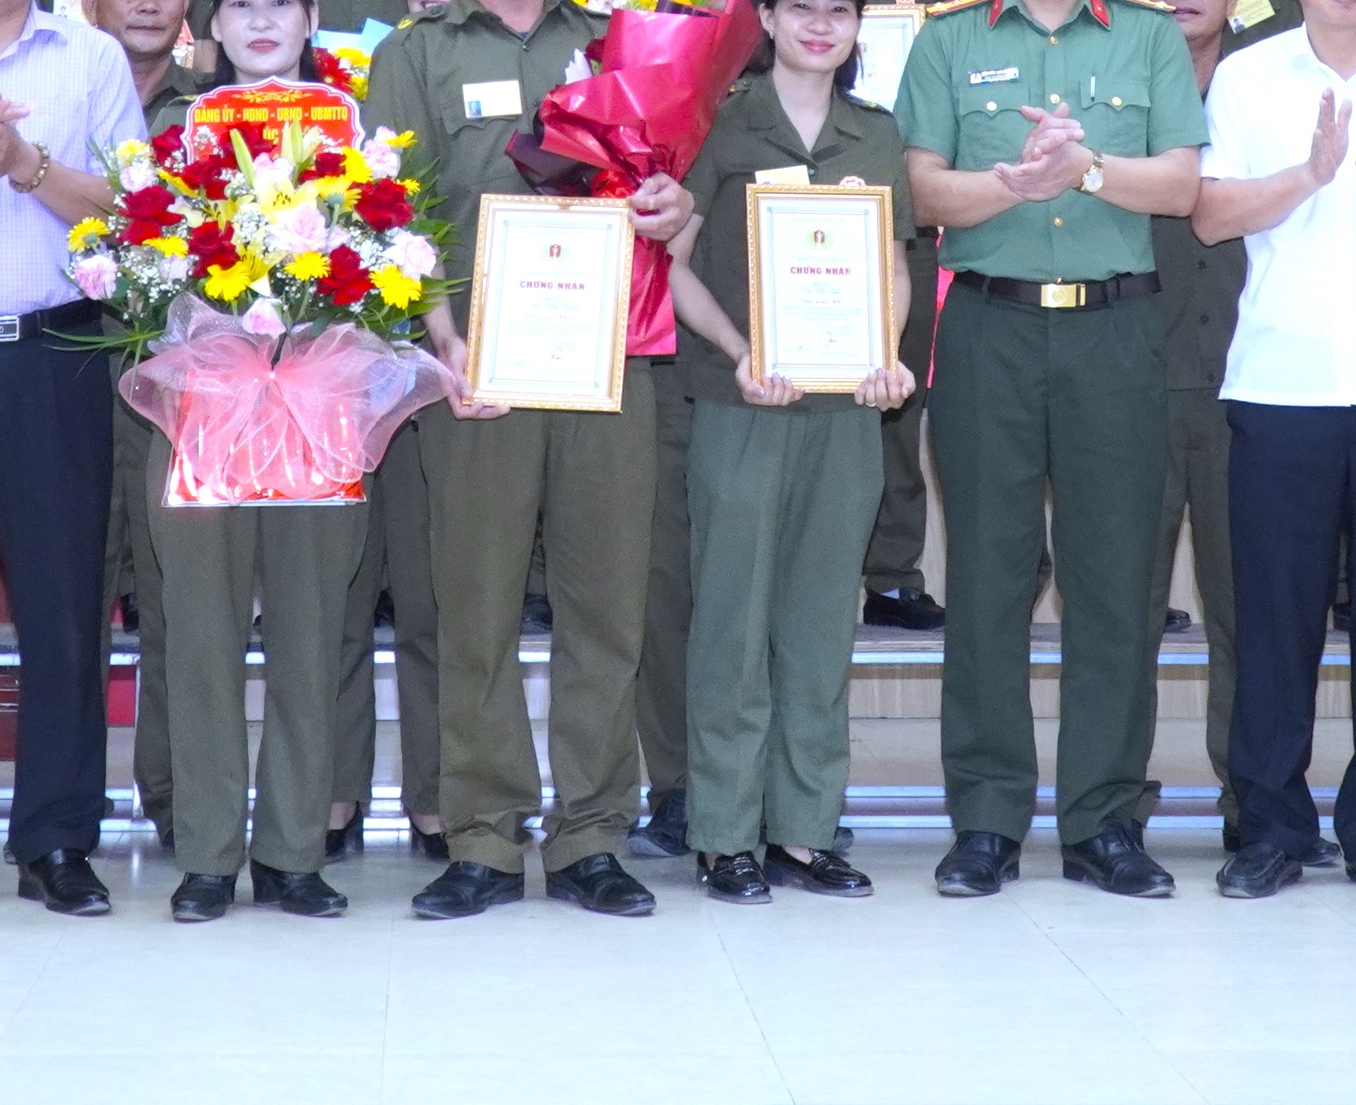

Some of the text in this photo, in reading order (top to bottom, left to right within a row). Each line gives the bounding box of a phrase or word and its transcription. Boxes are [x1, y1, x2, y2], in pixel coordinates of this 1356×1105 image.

[195, 106, 221, 123] ĐẢNG
[222, 105, 235, 123] ỦY
[243, 108, 270, 123] HĐND
[277, 107, 303, 121] UBND
